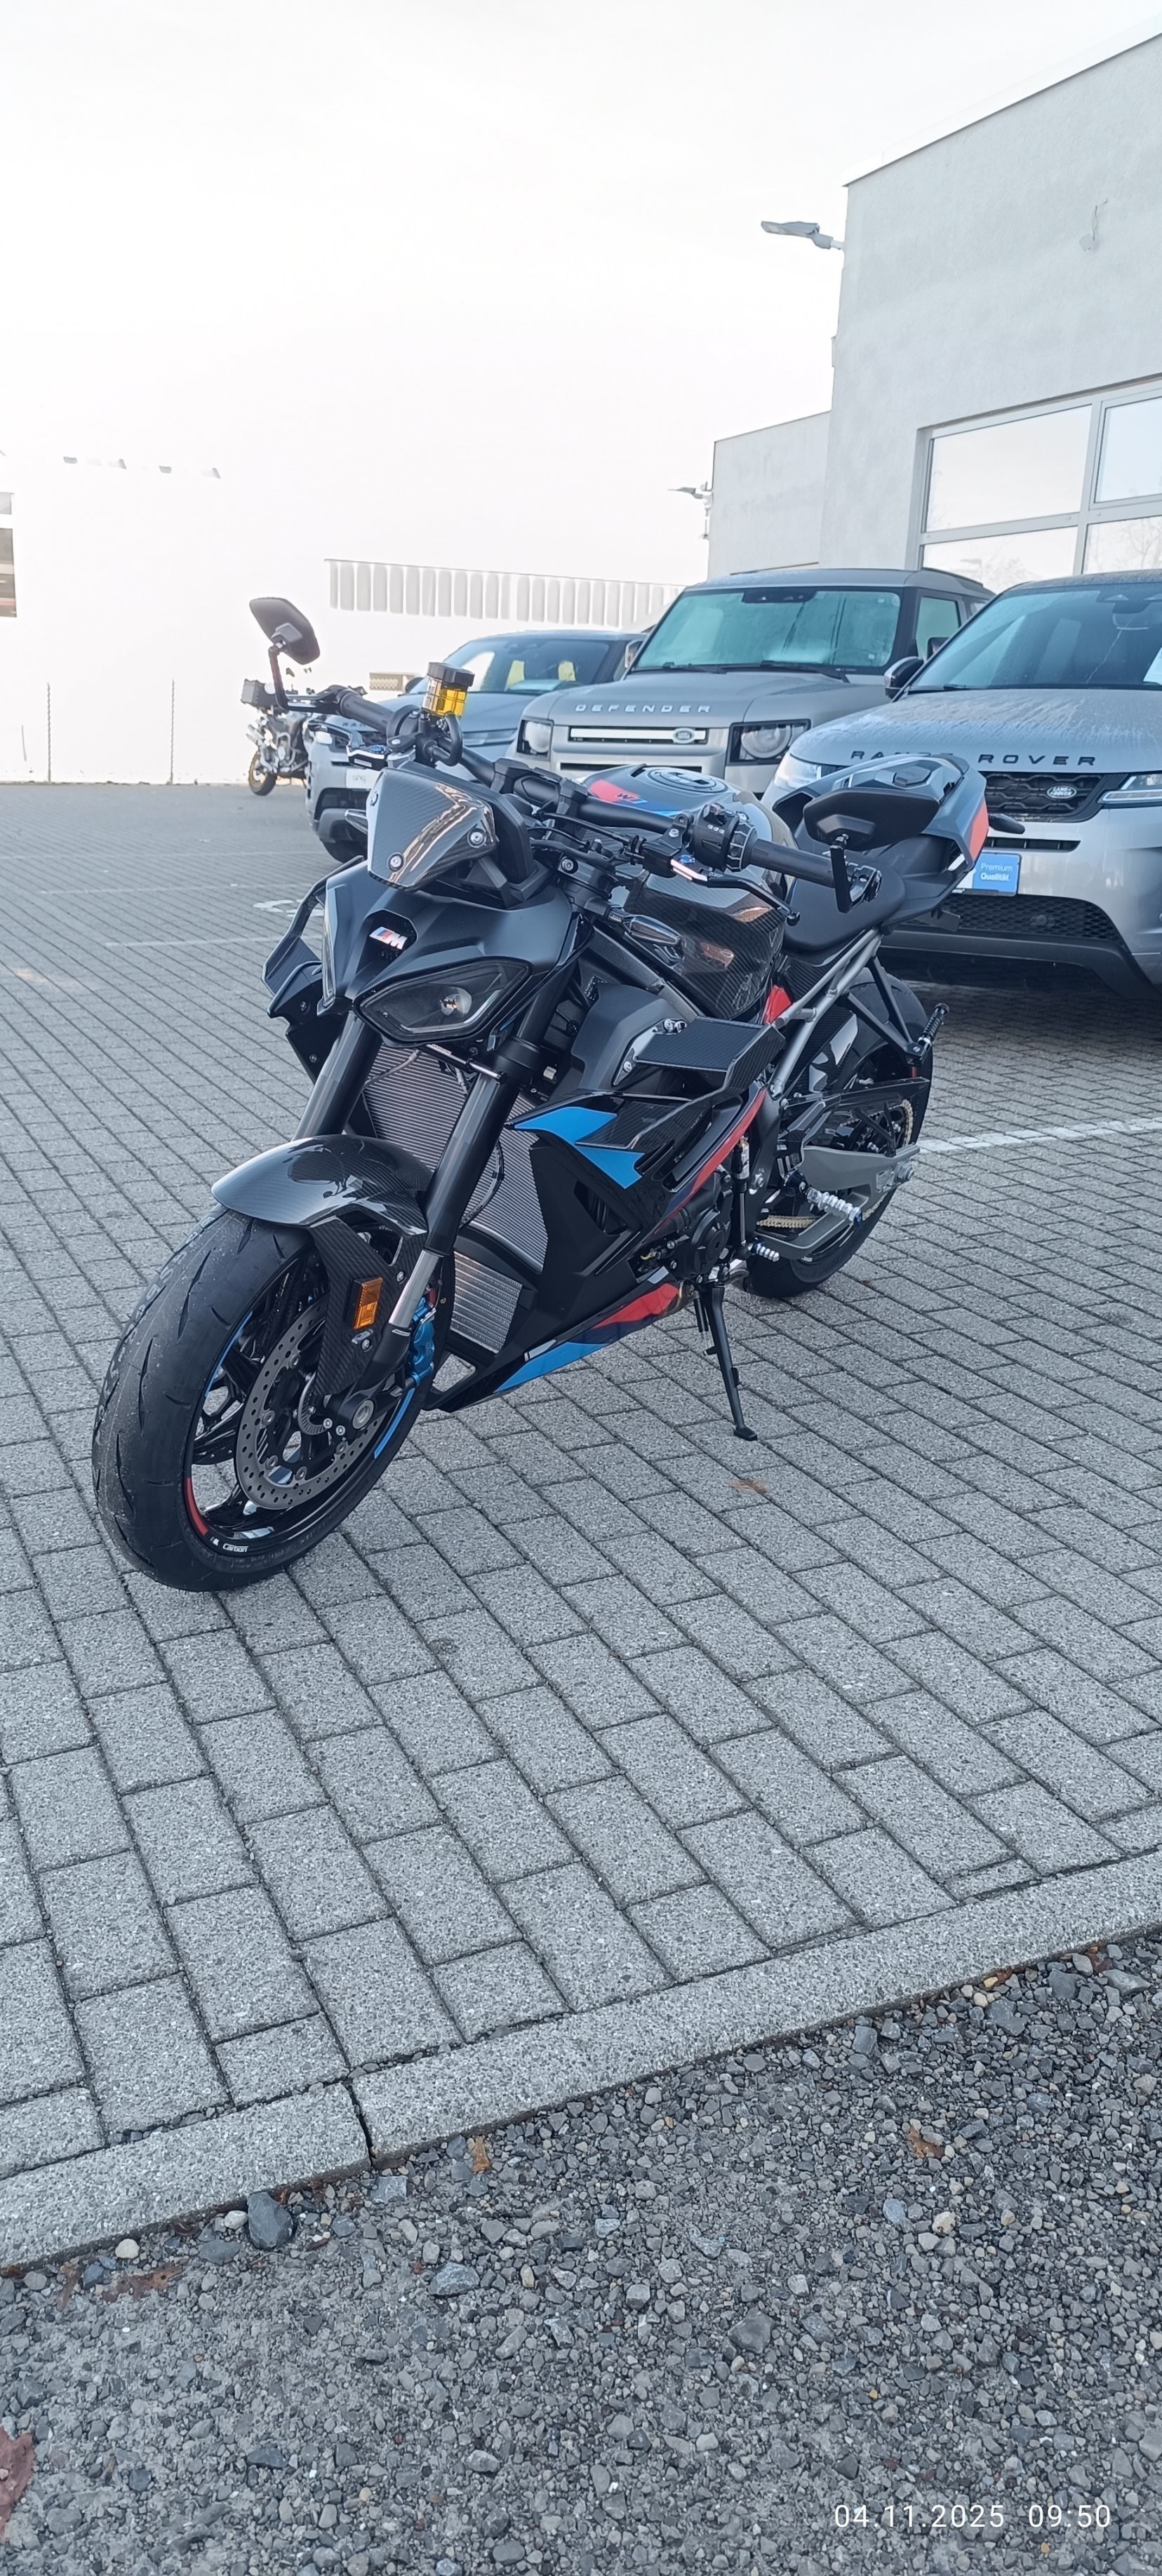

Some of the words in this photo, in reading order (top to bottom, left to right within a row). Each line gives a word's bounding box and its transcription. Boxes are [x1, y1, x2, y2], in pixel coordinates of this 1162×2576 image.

[575, 704, 710, 713] DEFENDER
[977, 753, 1096, 766] ROVER
[981, 862, 1013, 872] Premium
[222, 1543, 249, 1552] Carbon
